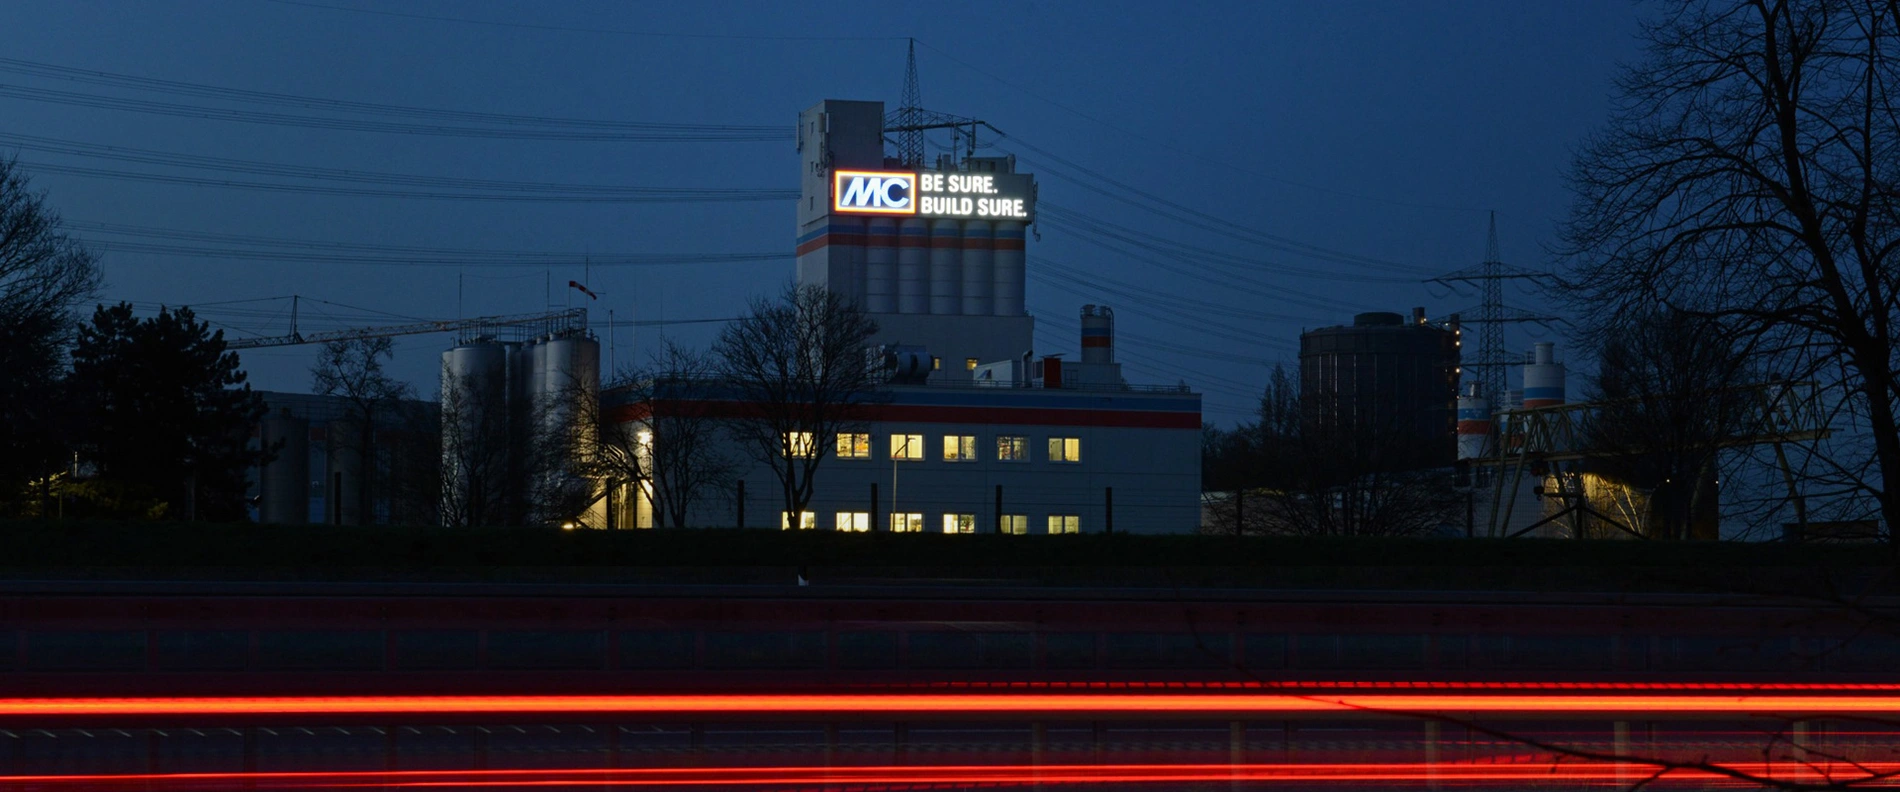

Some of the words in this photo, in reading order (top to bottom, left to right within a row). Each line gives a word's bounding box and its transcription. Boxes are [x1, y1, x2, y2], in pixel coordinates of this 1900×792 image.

[841, 176, 910, 208] MC
[921, 174, 944, 192] BE
[948, 175, 998, 194] SURE.
[921, 197, 973, 215] BUILD
[977, 199, 1028, 217] SURE.
